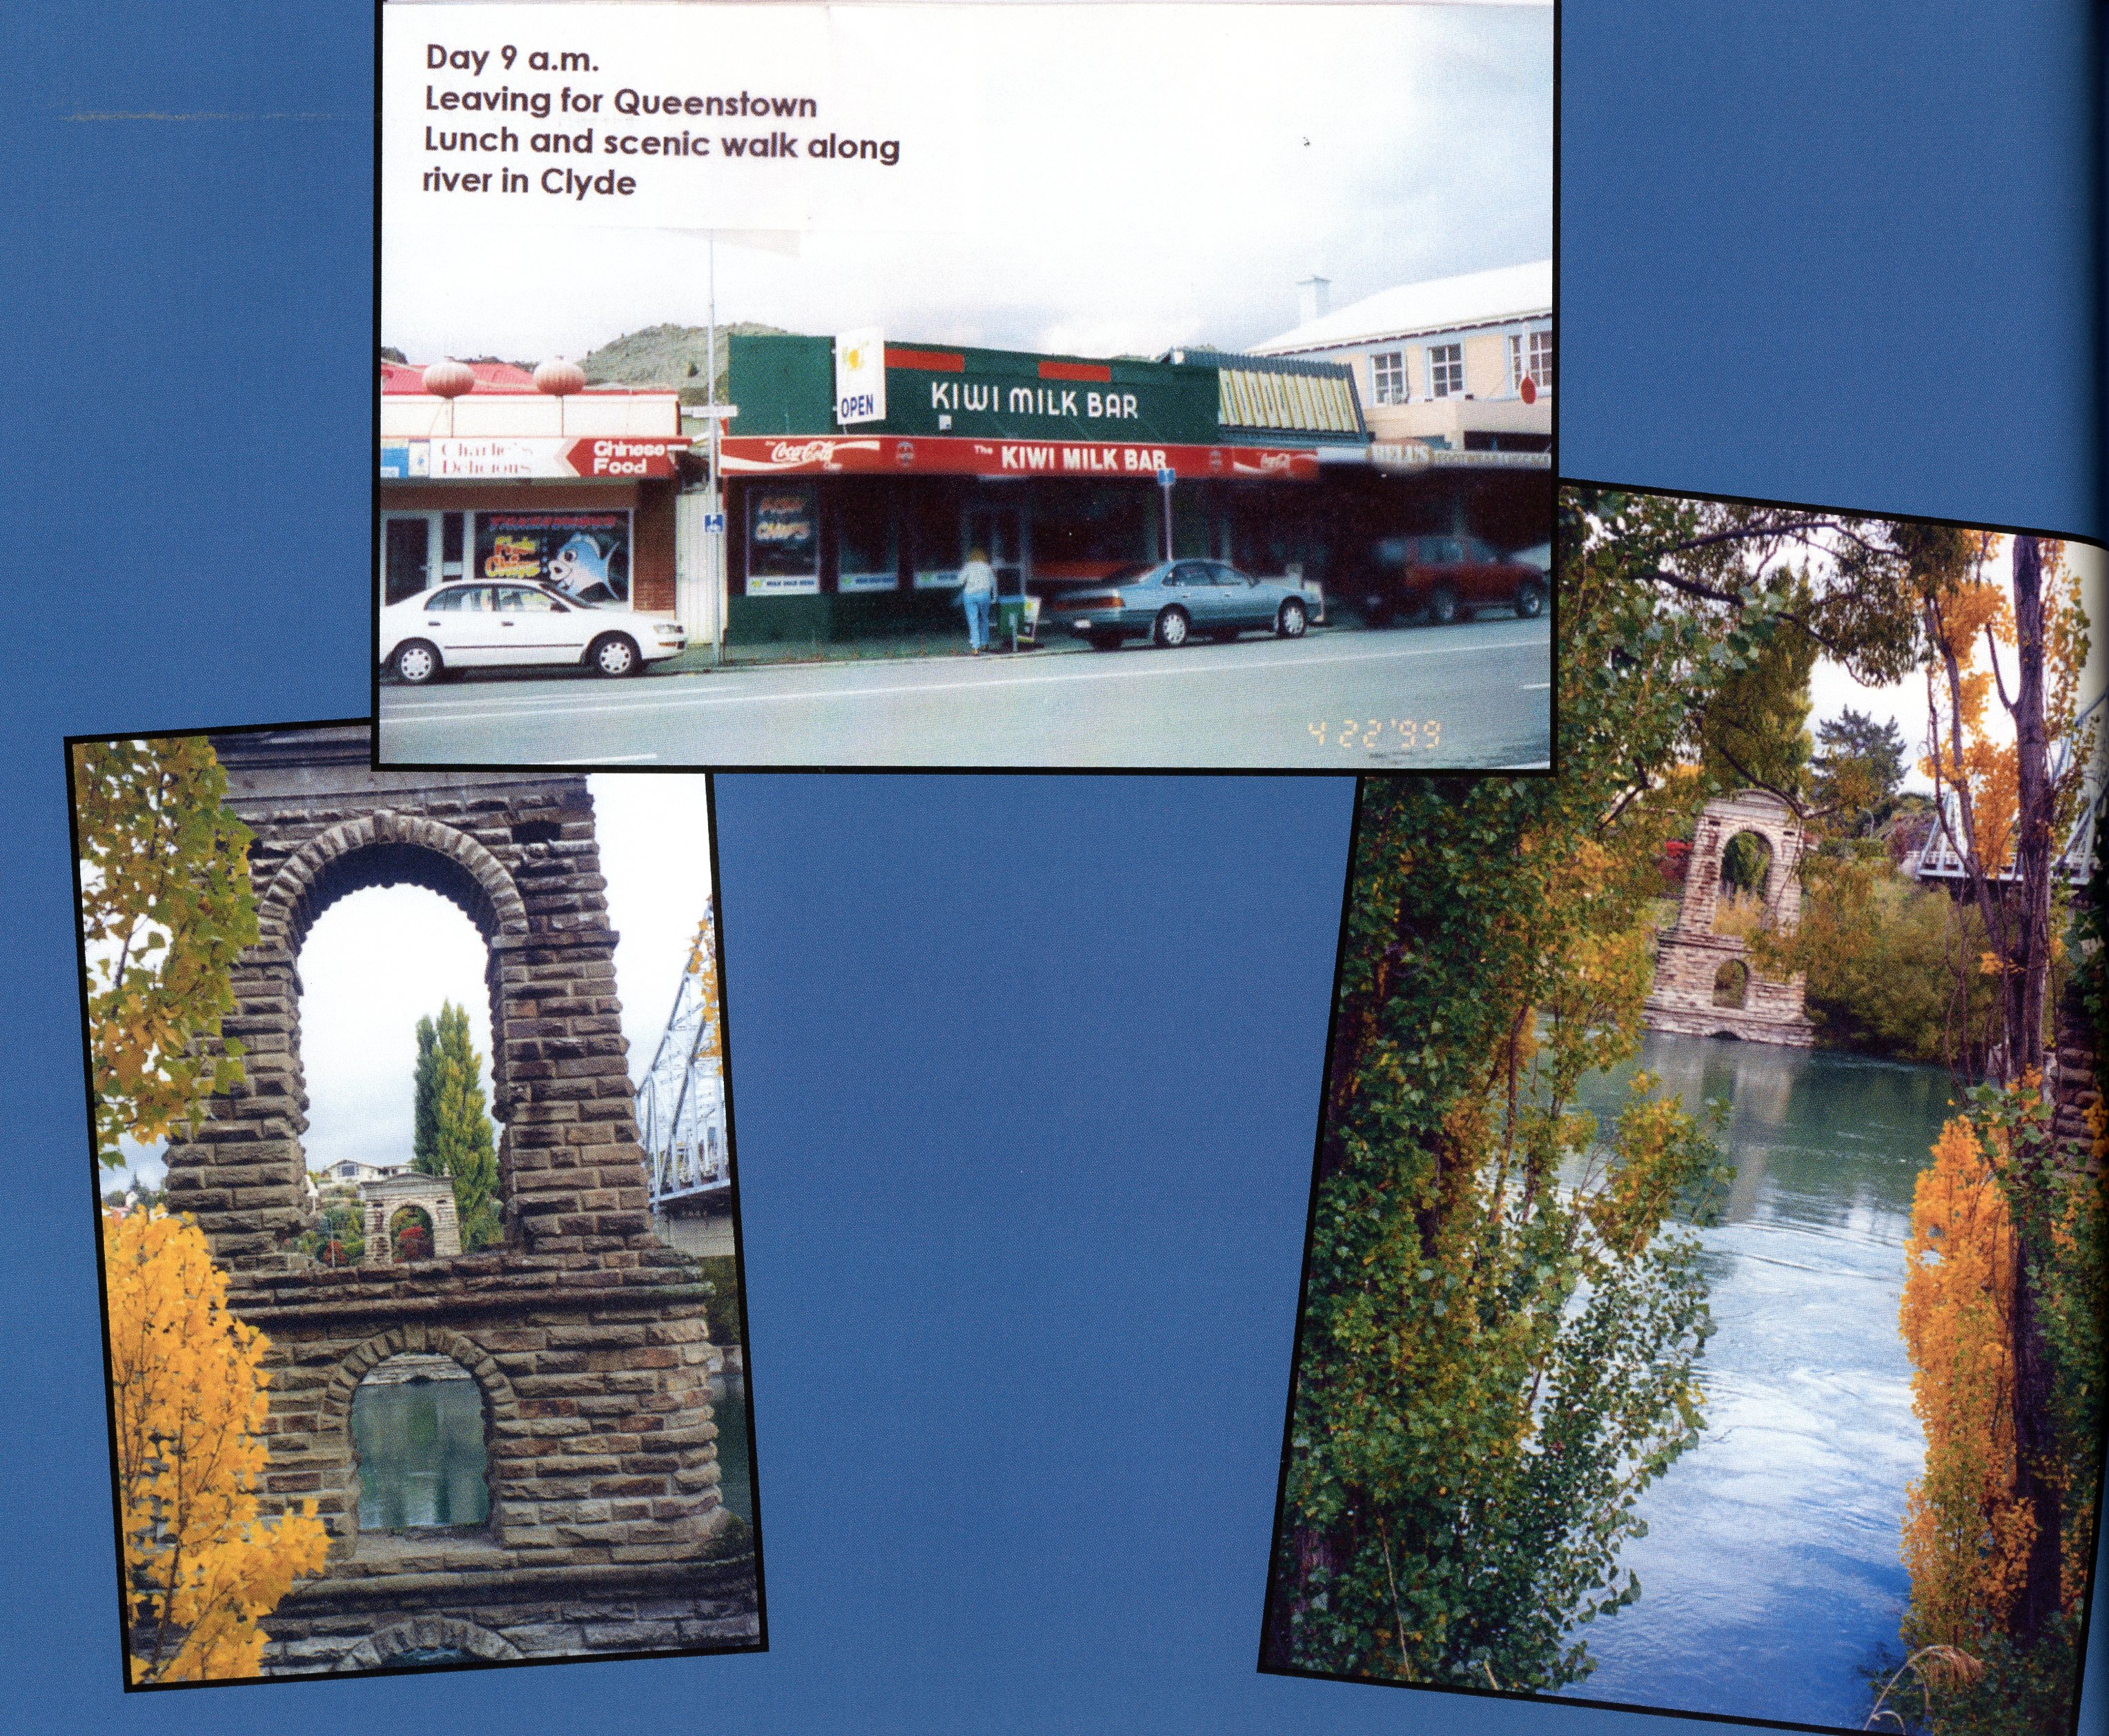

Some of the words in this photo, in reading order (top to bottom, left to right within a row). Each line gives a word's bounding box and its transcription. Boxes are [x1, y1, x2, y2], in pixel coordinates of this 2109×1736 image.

[841, 394, 874, 418] OPEN
[932, 382, 999, 412] KIWI
[1009, 387, 1078, 417] MILK
[1087, 392, 1138, 419] BAR
[593, 440, 666, 457] Chinese
[974, 444, 994, 455] The
[1001, 445, 1055, 470] KIWI
[1062, 447, 1119, 471] MILK
[1124, 448, 1167, 471] BAR
[593, 457, 648, 475] Food
